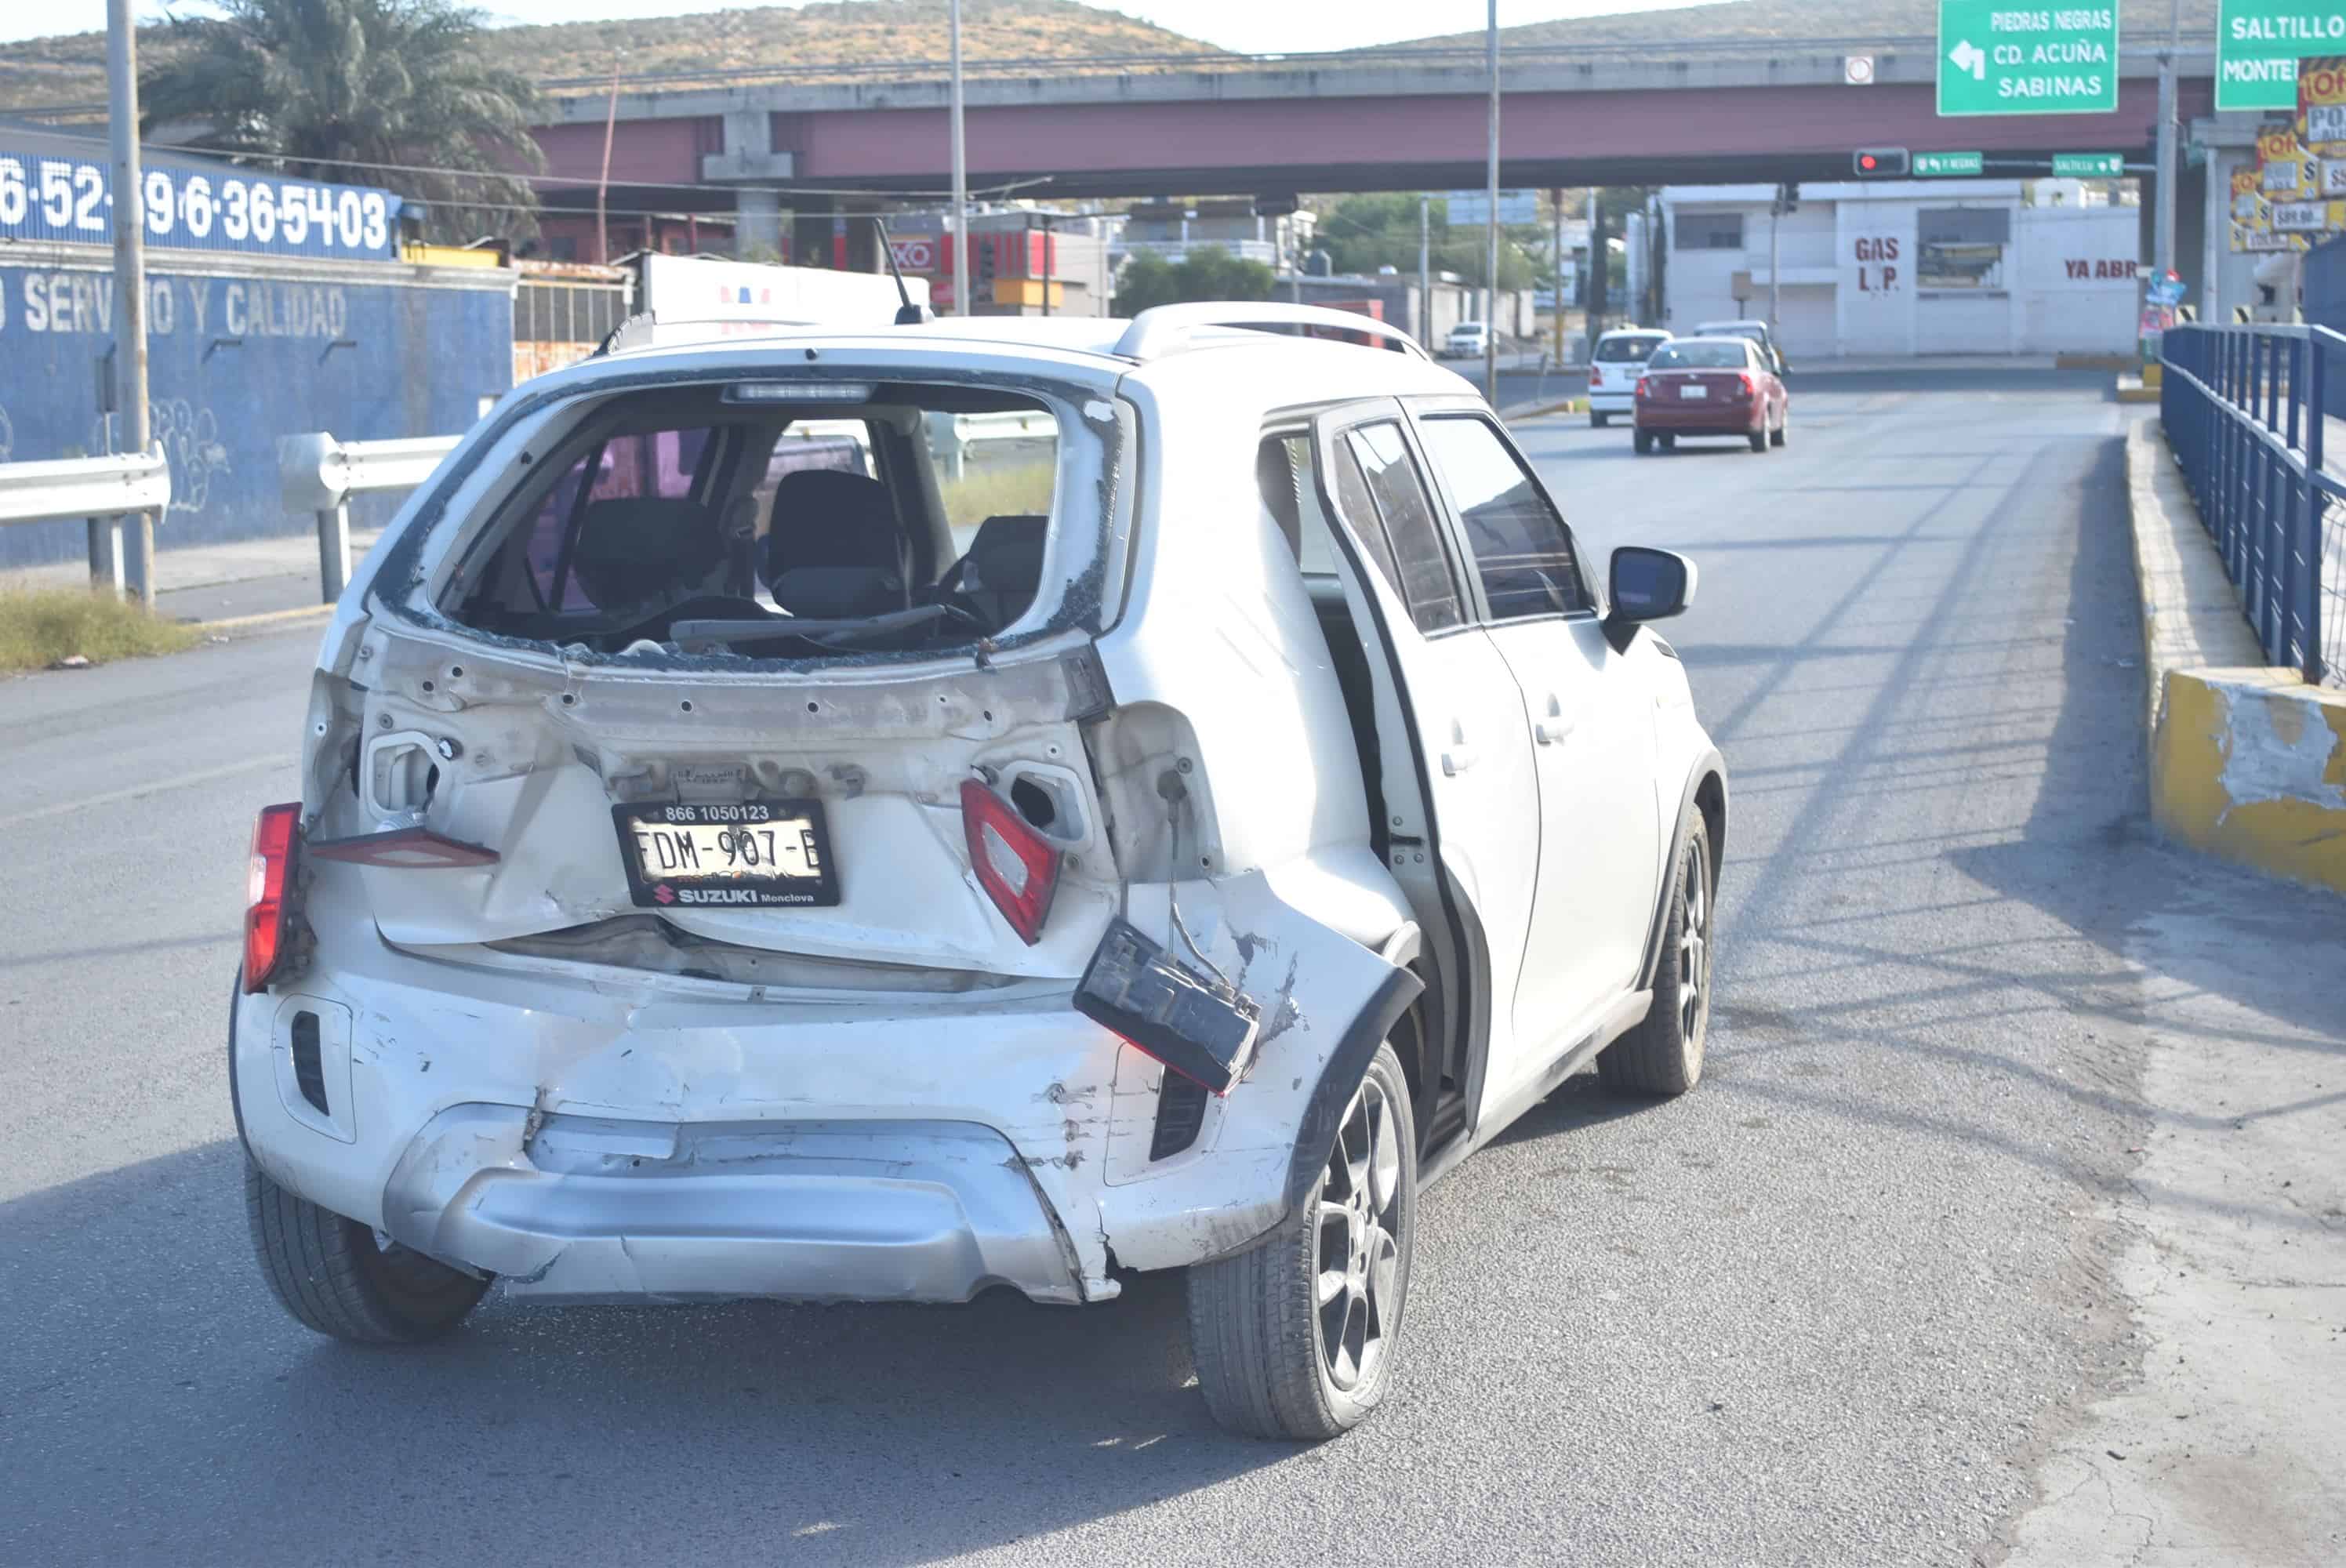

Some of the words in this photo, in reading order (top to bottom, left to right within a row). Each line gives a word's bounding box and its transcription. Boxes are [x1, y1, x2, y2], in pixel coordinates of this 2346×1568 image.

[1991, 11, 2050, 31] PIEDRAS
[2054, 9, 2112, 31] NEGRAS
[2231, 15, 2345, 39] SALTILLO
[2032, 38, 2107, 64] ACUÑA
[1998, 75, 2102, 97] SABINAS
[1856, 237, 1898, 261] GAS
[2065, 259, 2090, 280] YA
[188, 279, 212, 335] Y
[226, 284, 347, 339] CALIDAD
[666, 807, 695, 821] 866
[699, 806, 770, 821] 1050123
[678, 889, 758, 903] SUZUKI
[761, 892, 815, 902] Monclova
